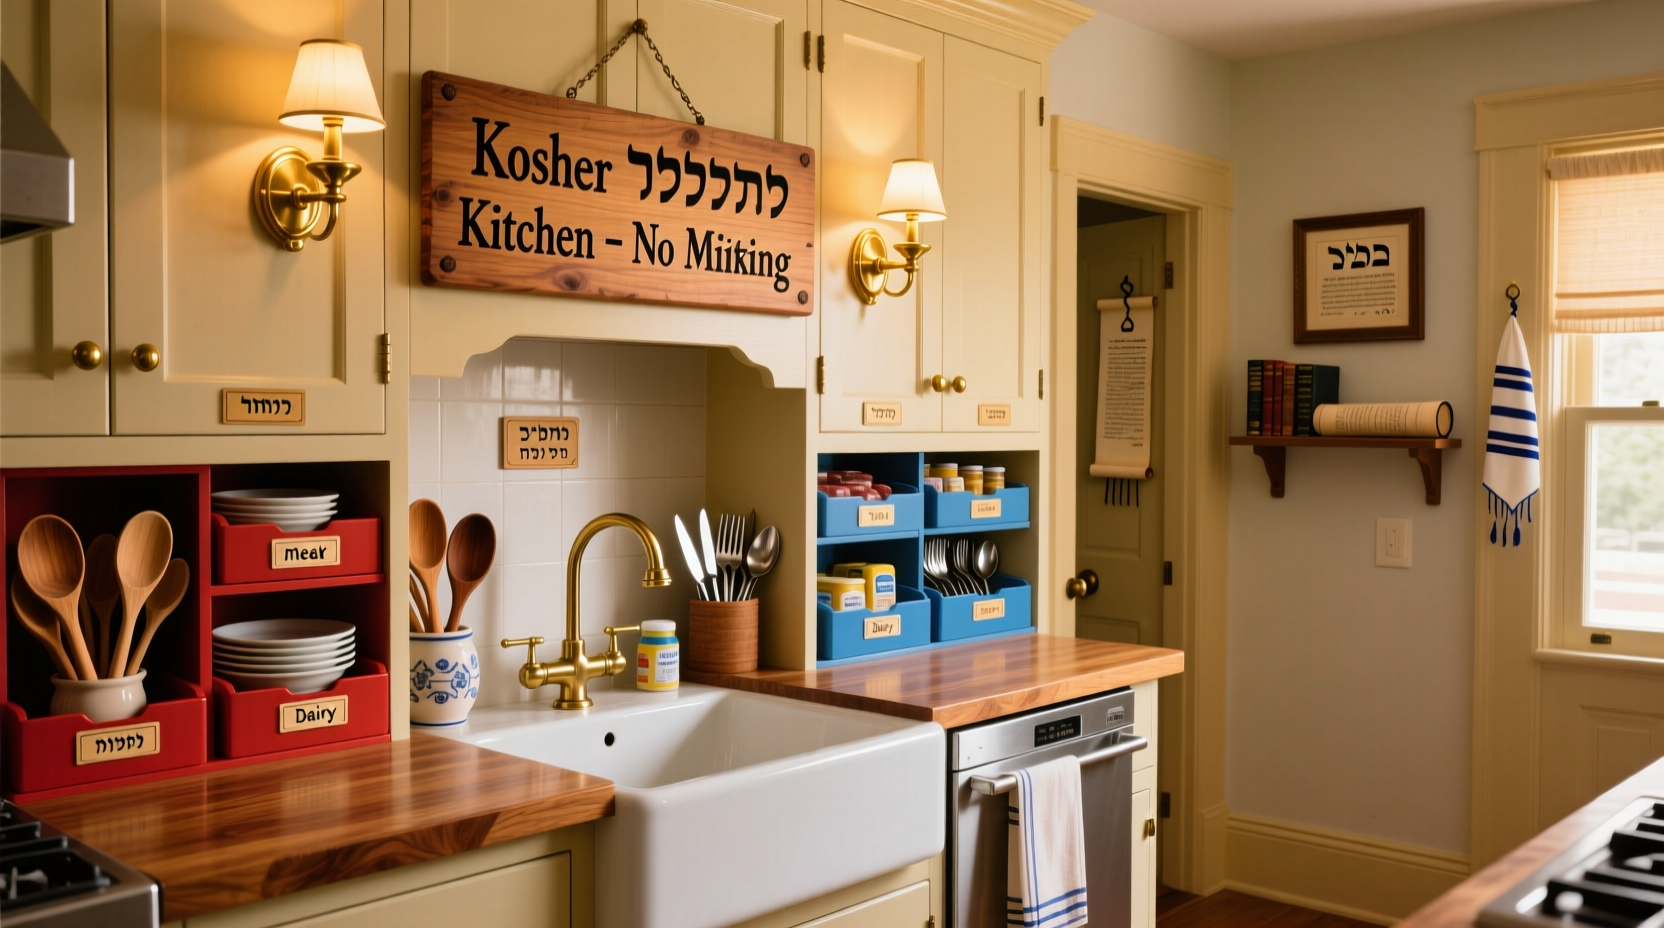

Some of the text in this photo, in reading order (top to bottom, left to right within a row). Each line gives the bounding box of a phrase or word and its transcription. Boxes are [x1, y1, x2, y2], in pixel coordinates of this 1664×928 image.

[471, 116, 612, 194] Kosher
[458, 196, 595, 260] Kitchen
[632, 221, 675, 267] No
[295, 704, 337, 724] Dairy
